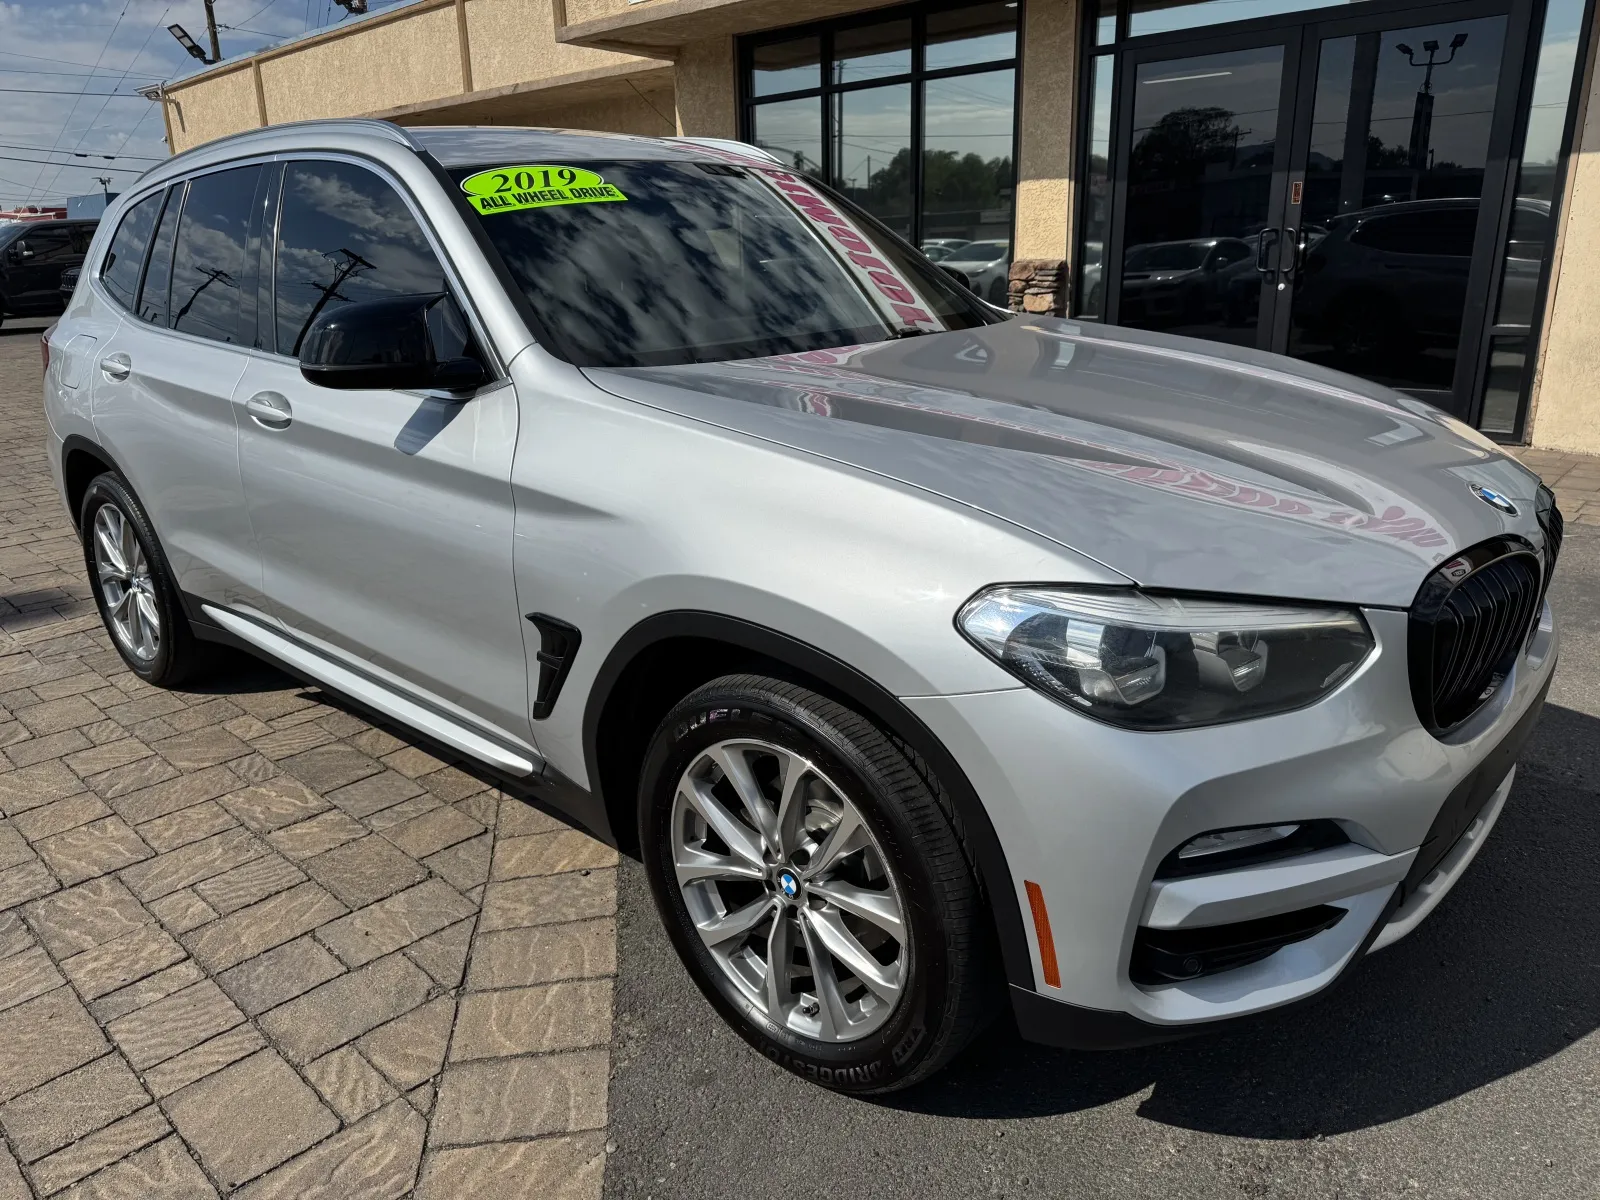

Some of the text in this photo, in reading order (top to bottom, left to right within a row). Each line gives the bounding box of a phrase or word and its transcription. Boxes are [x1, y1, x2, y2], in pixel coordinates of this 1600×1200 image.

[491, 169, 577, 193] 2019
[480, 186, 617, 210] ALL WHEEL DRIVE
[759, 1036, 886, 1085] BRIDGESTO
